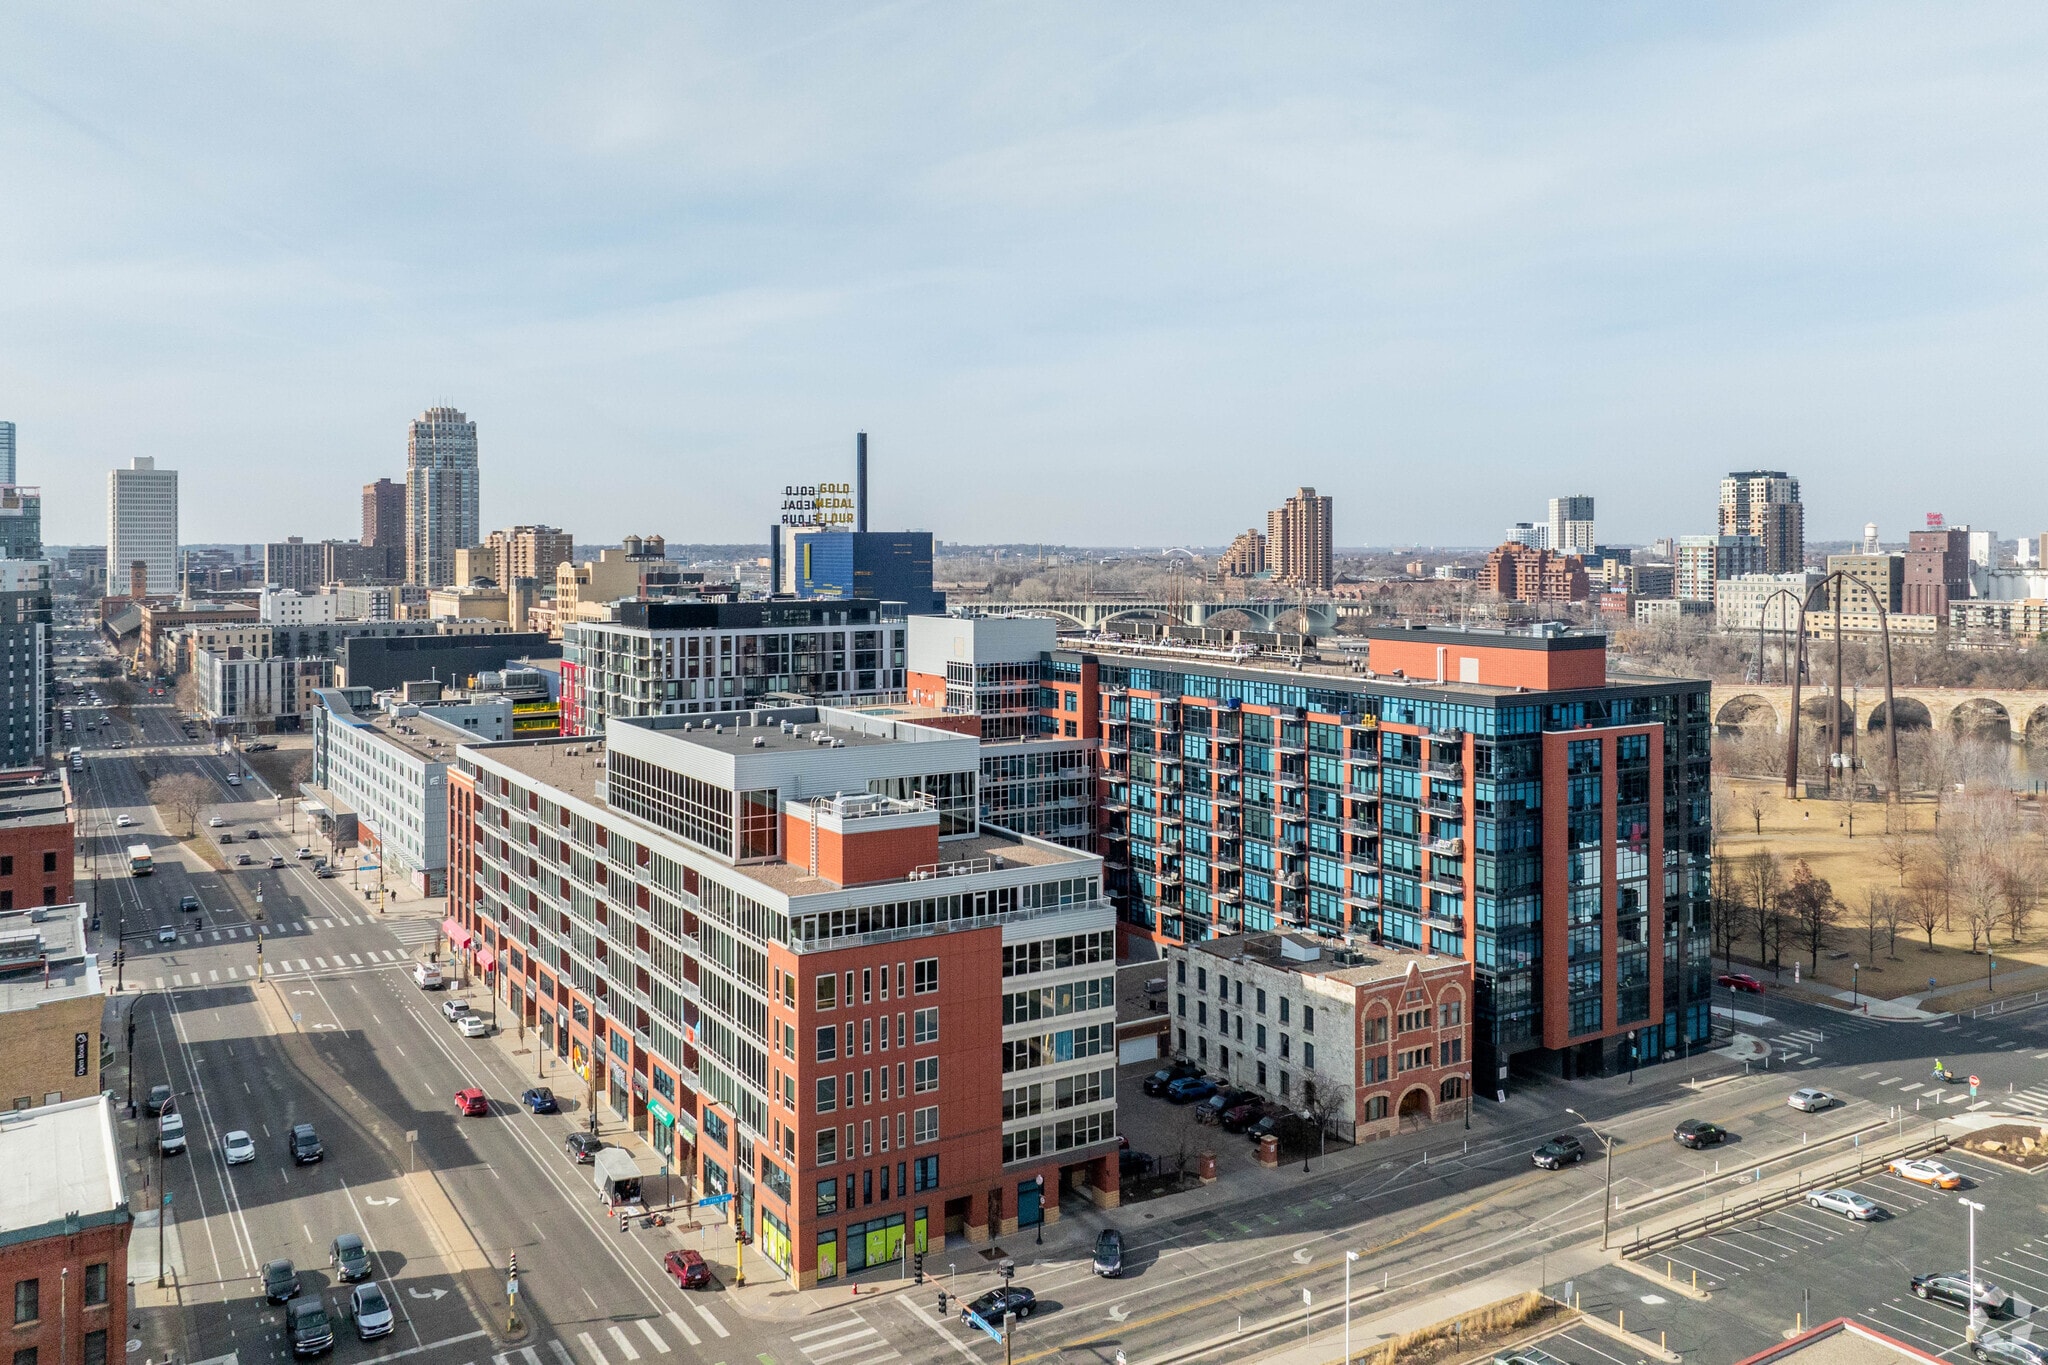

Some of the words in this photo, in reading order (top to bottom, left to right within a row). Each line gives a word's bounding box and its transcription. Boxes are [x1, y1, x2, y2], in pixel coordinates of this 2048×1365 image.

[820, 483, 849, 493] GOLD
[815, 498, 854, 508] MEDAL
[815, 513, 854, 523] FLOUR
[77, 1060, 85, 1075] Open
